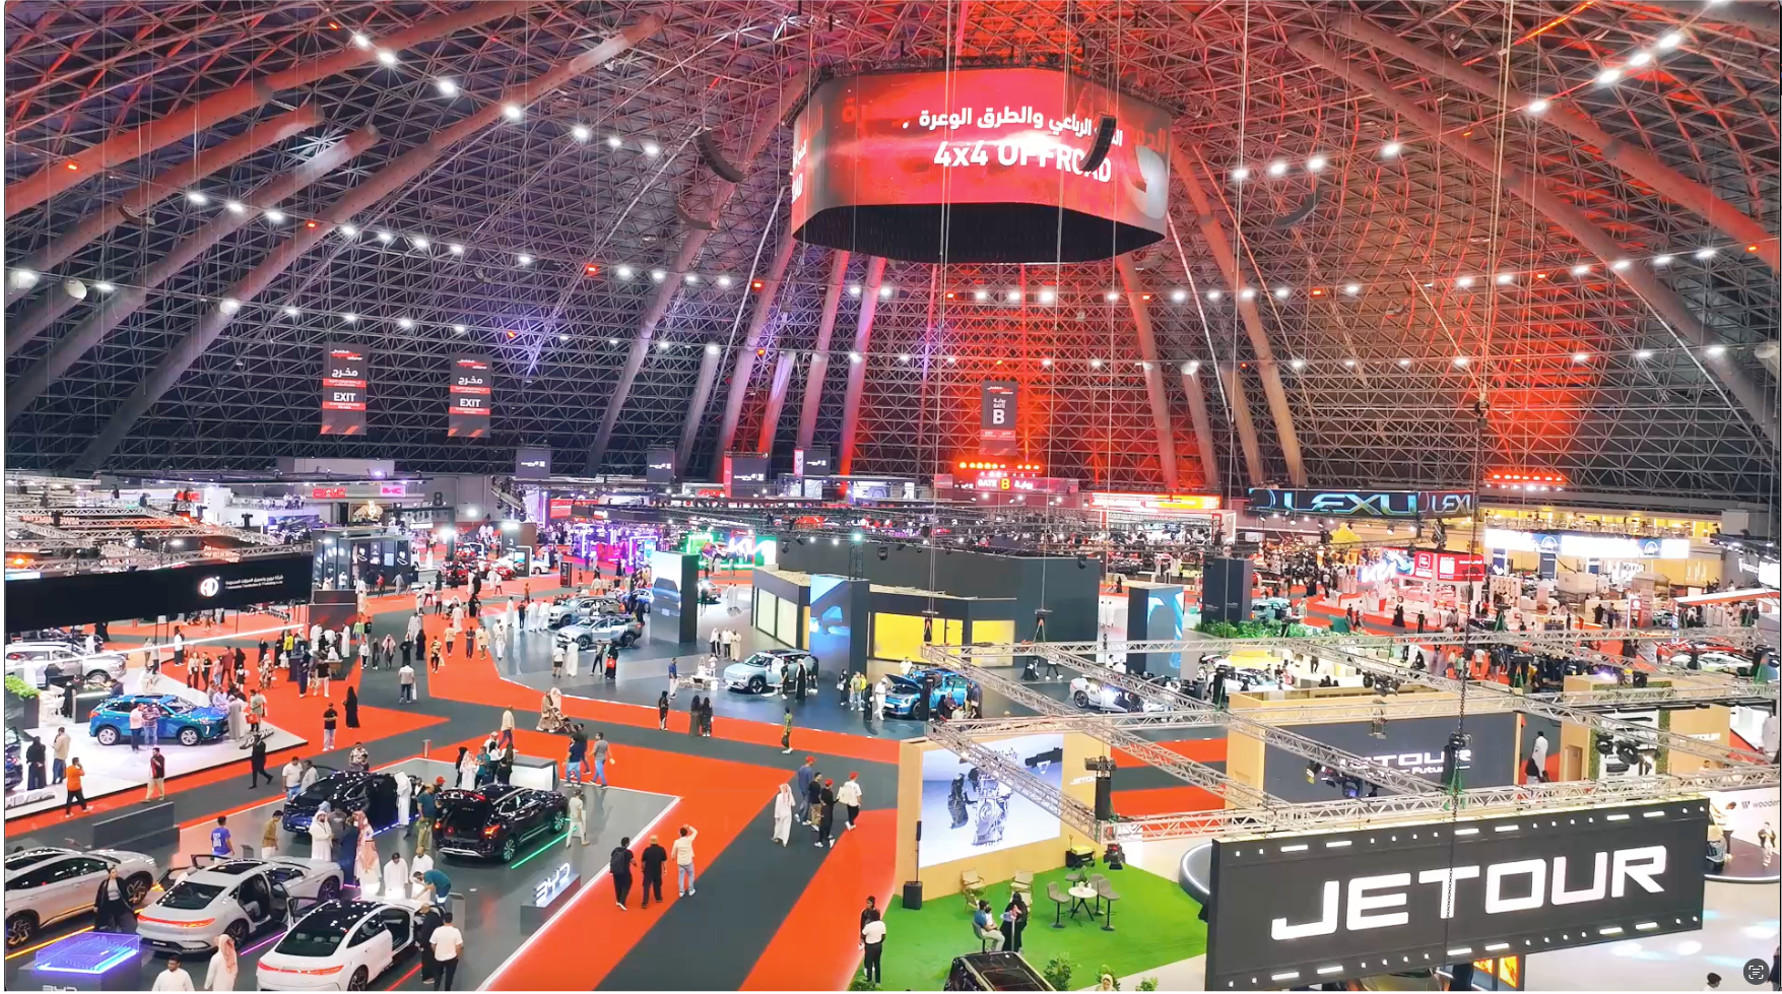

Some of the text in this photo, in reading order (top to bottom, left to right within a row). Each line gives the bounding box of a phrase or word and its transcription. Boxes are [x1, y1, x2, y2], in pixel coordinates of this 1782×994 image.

[919, 107, 972, 131] الوعرة
[977, 106, 1044, 129] والطرق
[1049, 113, 1092, 138] الرباعي
[933, 140, 988, 168] 4x4
[331, 367, 359, 378] مخرج
[333, 392, 356, 402] EXIT
[459, 398, 481, 408] EXIT
[992, 409, 1005, 425] B
[1000, 479, 1011, 490] B
[433, 491, 444, 507] 8
[1270, 844, 1667, 941] JETOUR
